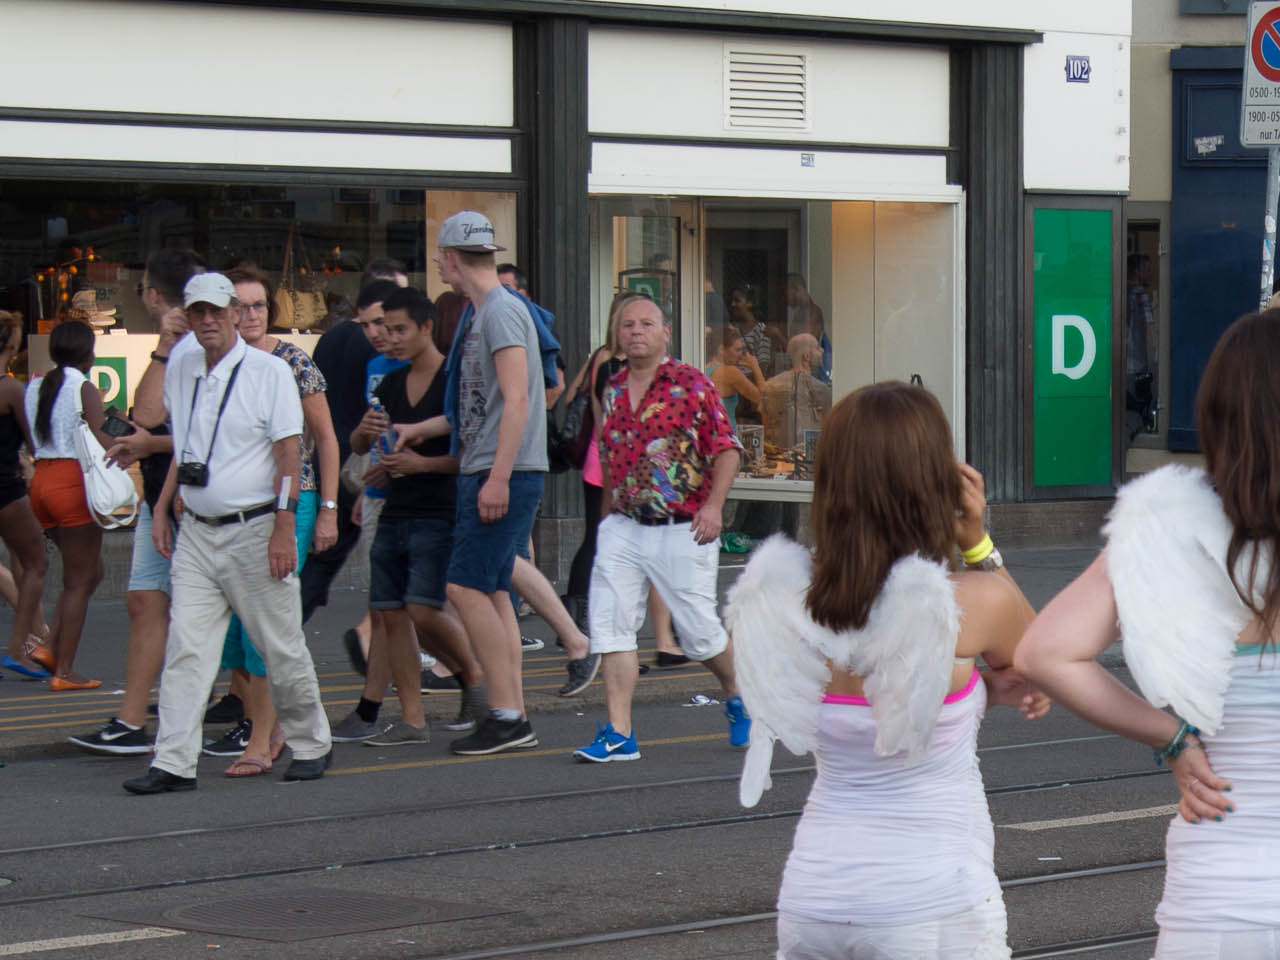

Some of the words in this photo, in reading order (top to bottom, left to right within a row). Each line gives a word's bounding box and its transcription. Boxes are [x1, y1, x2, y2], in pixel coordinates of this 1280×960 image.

[1069, 59, 1089, 79] 102
[1259, 131, 1272, 140] nur
[1051, 314, 1097, 380] D
[89, 365, 121, 403] D
